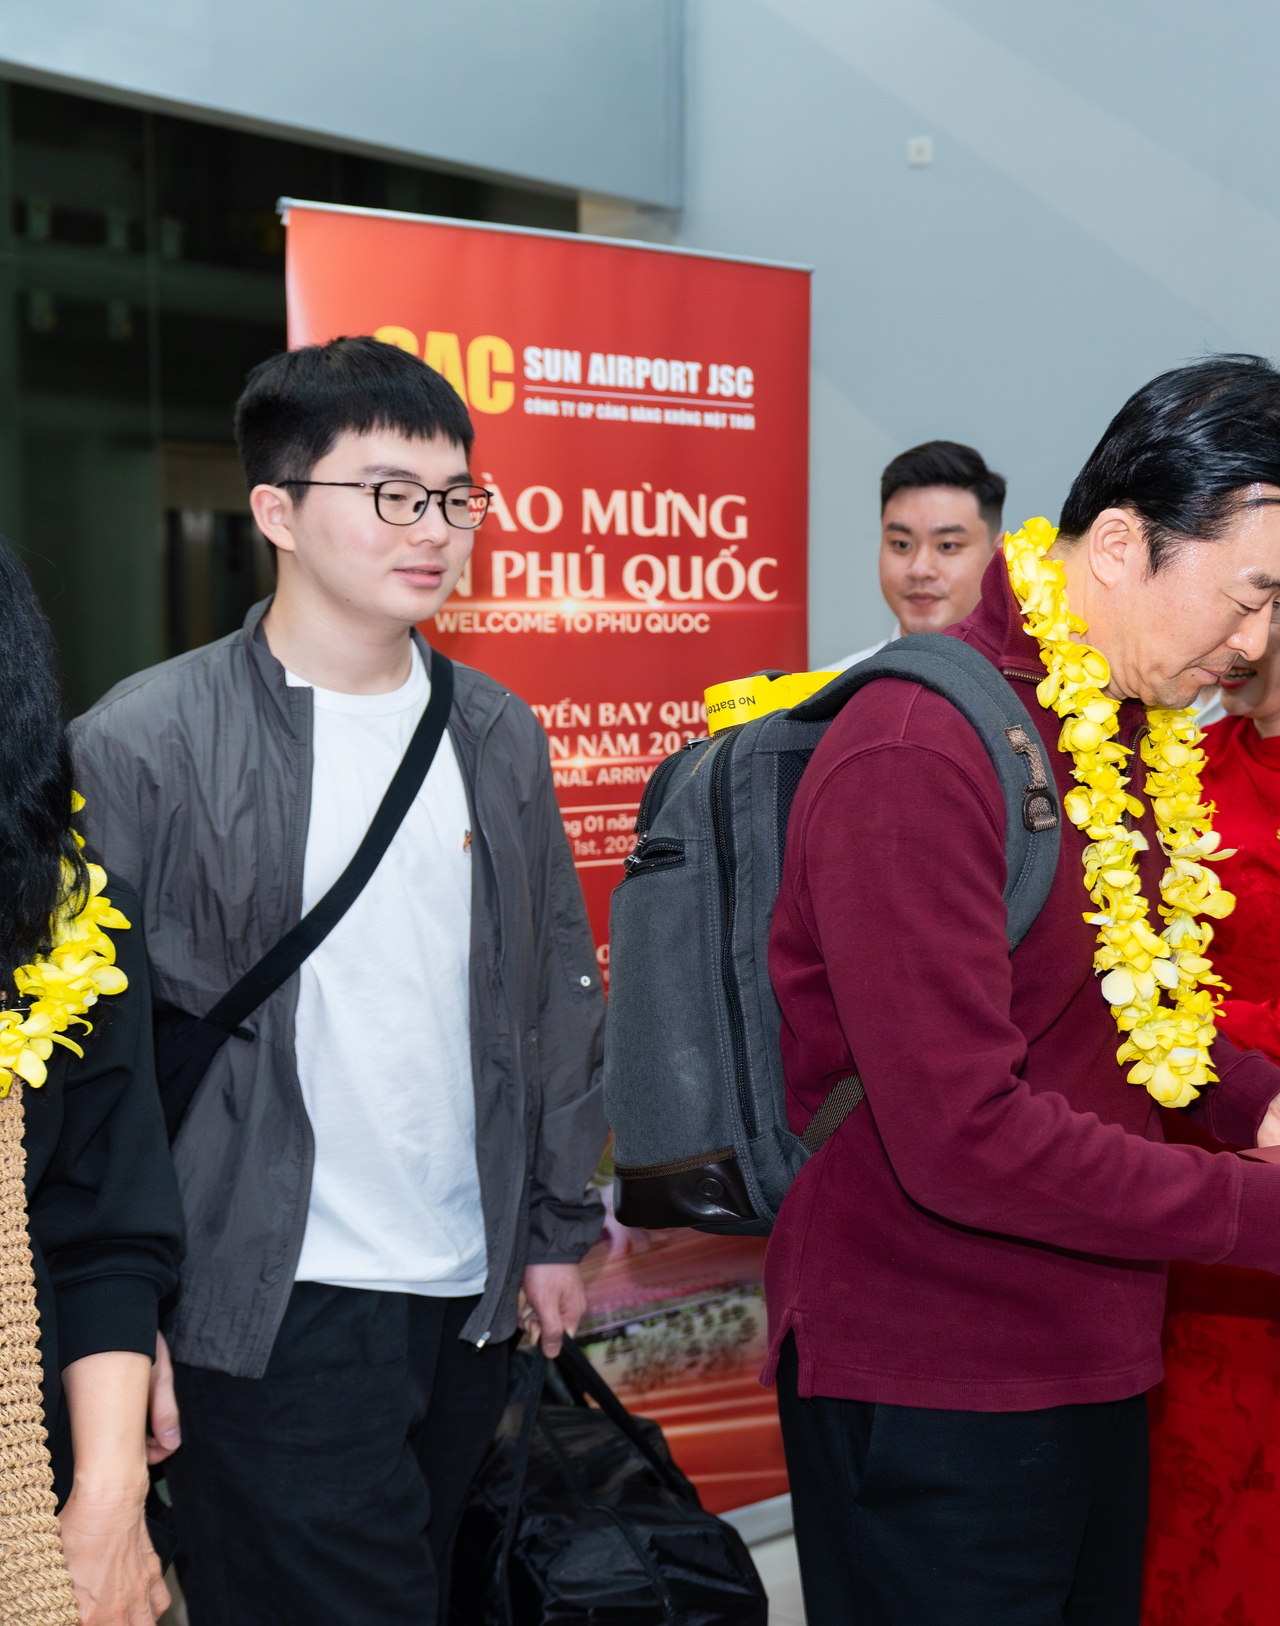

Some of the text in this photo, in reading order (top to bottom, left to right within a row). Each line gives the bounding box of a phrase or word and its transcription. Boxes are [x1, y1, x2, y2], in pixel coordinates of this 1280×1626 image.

[523, 346, 755, 399] SUN AIRPORT JSC
[475, 472, 748, 540] ÀO MỪNG
[491, 545, 605, 599] PHÚ
[622, 545, 779, 607] QUỐC
[434, 611, 711, 634] WELCOME TO PHU QUOC
[598, 702, 653, 727] BAY
[659, 700, 708, 729] QU
[707, 695, 756, 715] No Batte
[596, 766, 659, 786] ARRIV
[584, 815, 604, 833] 01
[604, 835, 639, 854] 202
